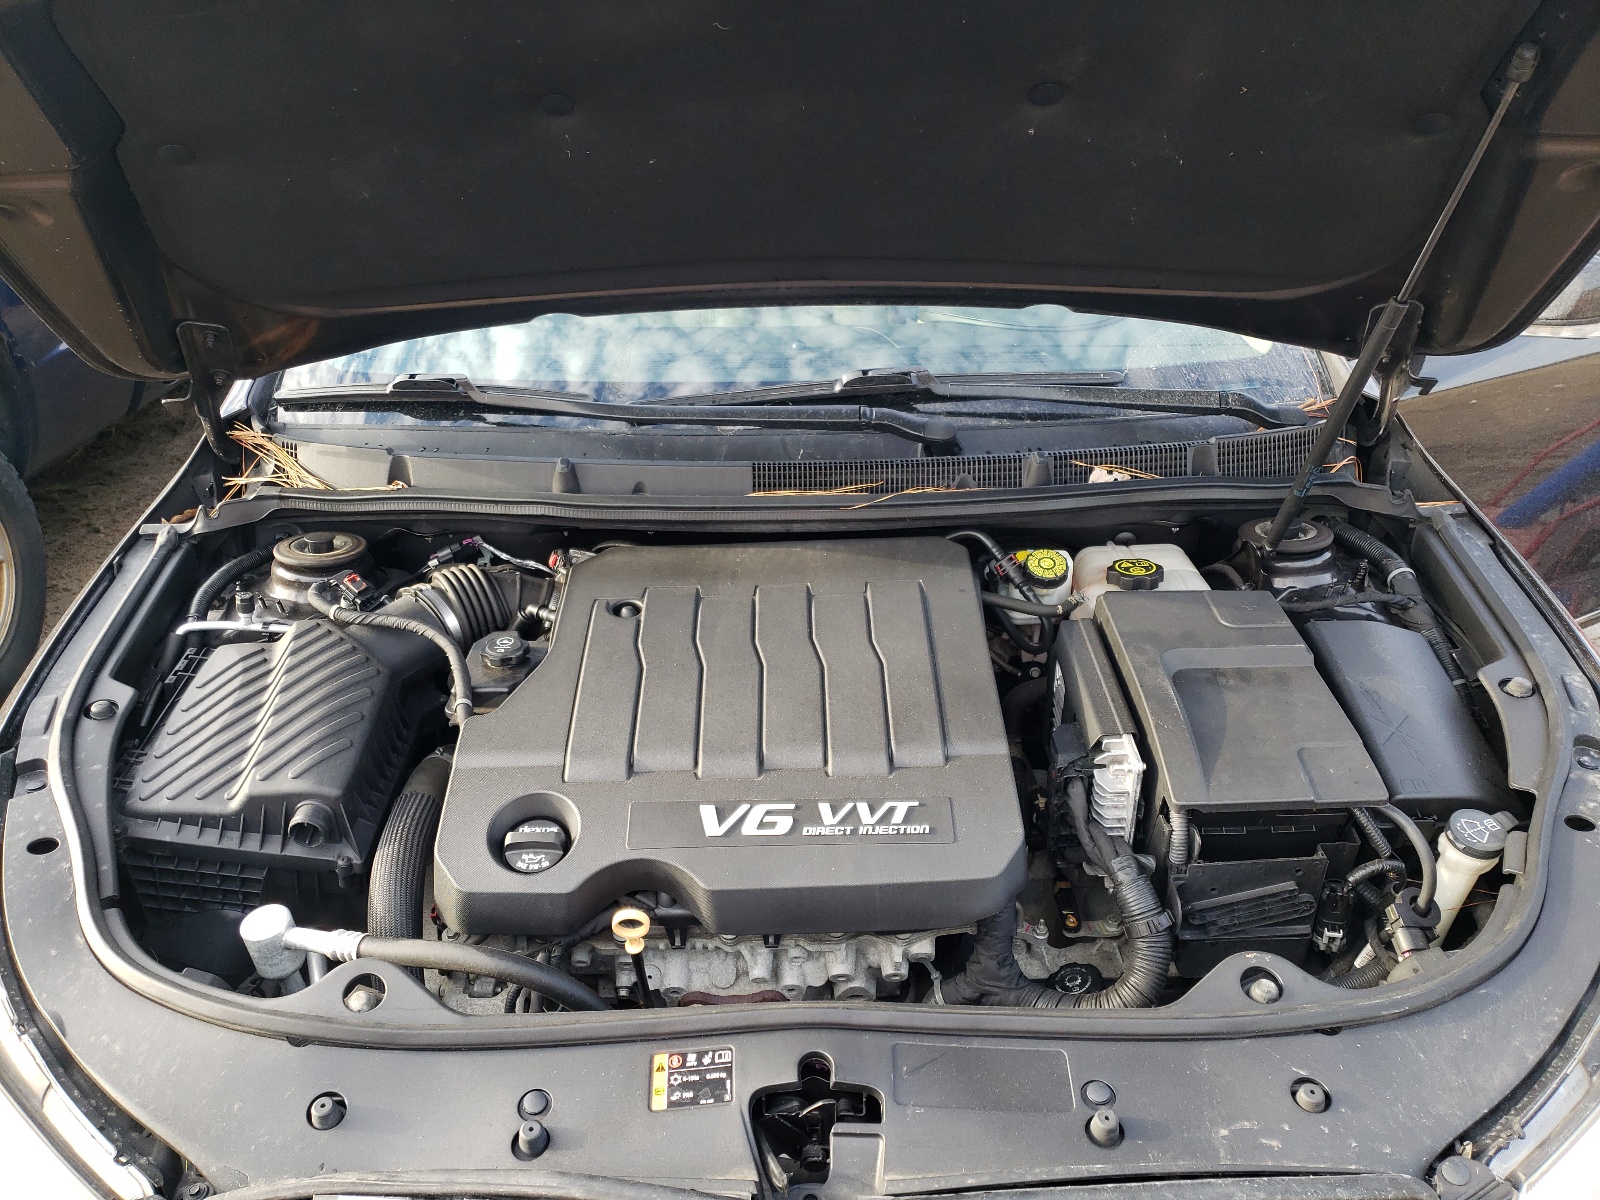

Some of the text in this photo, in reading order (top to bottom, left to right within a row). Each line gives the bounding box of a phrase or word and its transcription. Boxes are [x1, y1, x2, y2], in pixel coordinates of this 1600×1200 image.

[700, 803, 796, 837] V6
[818, 801, 920, 826] VVT
[802, 824, 930, 836] DIRECT INJECTION
